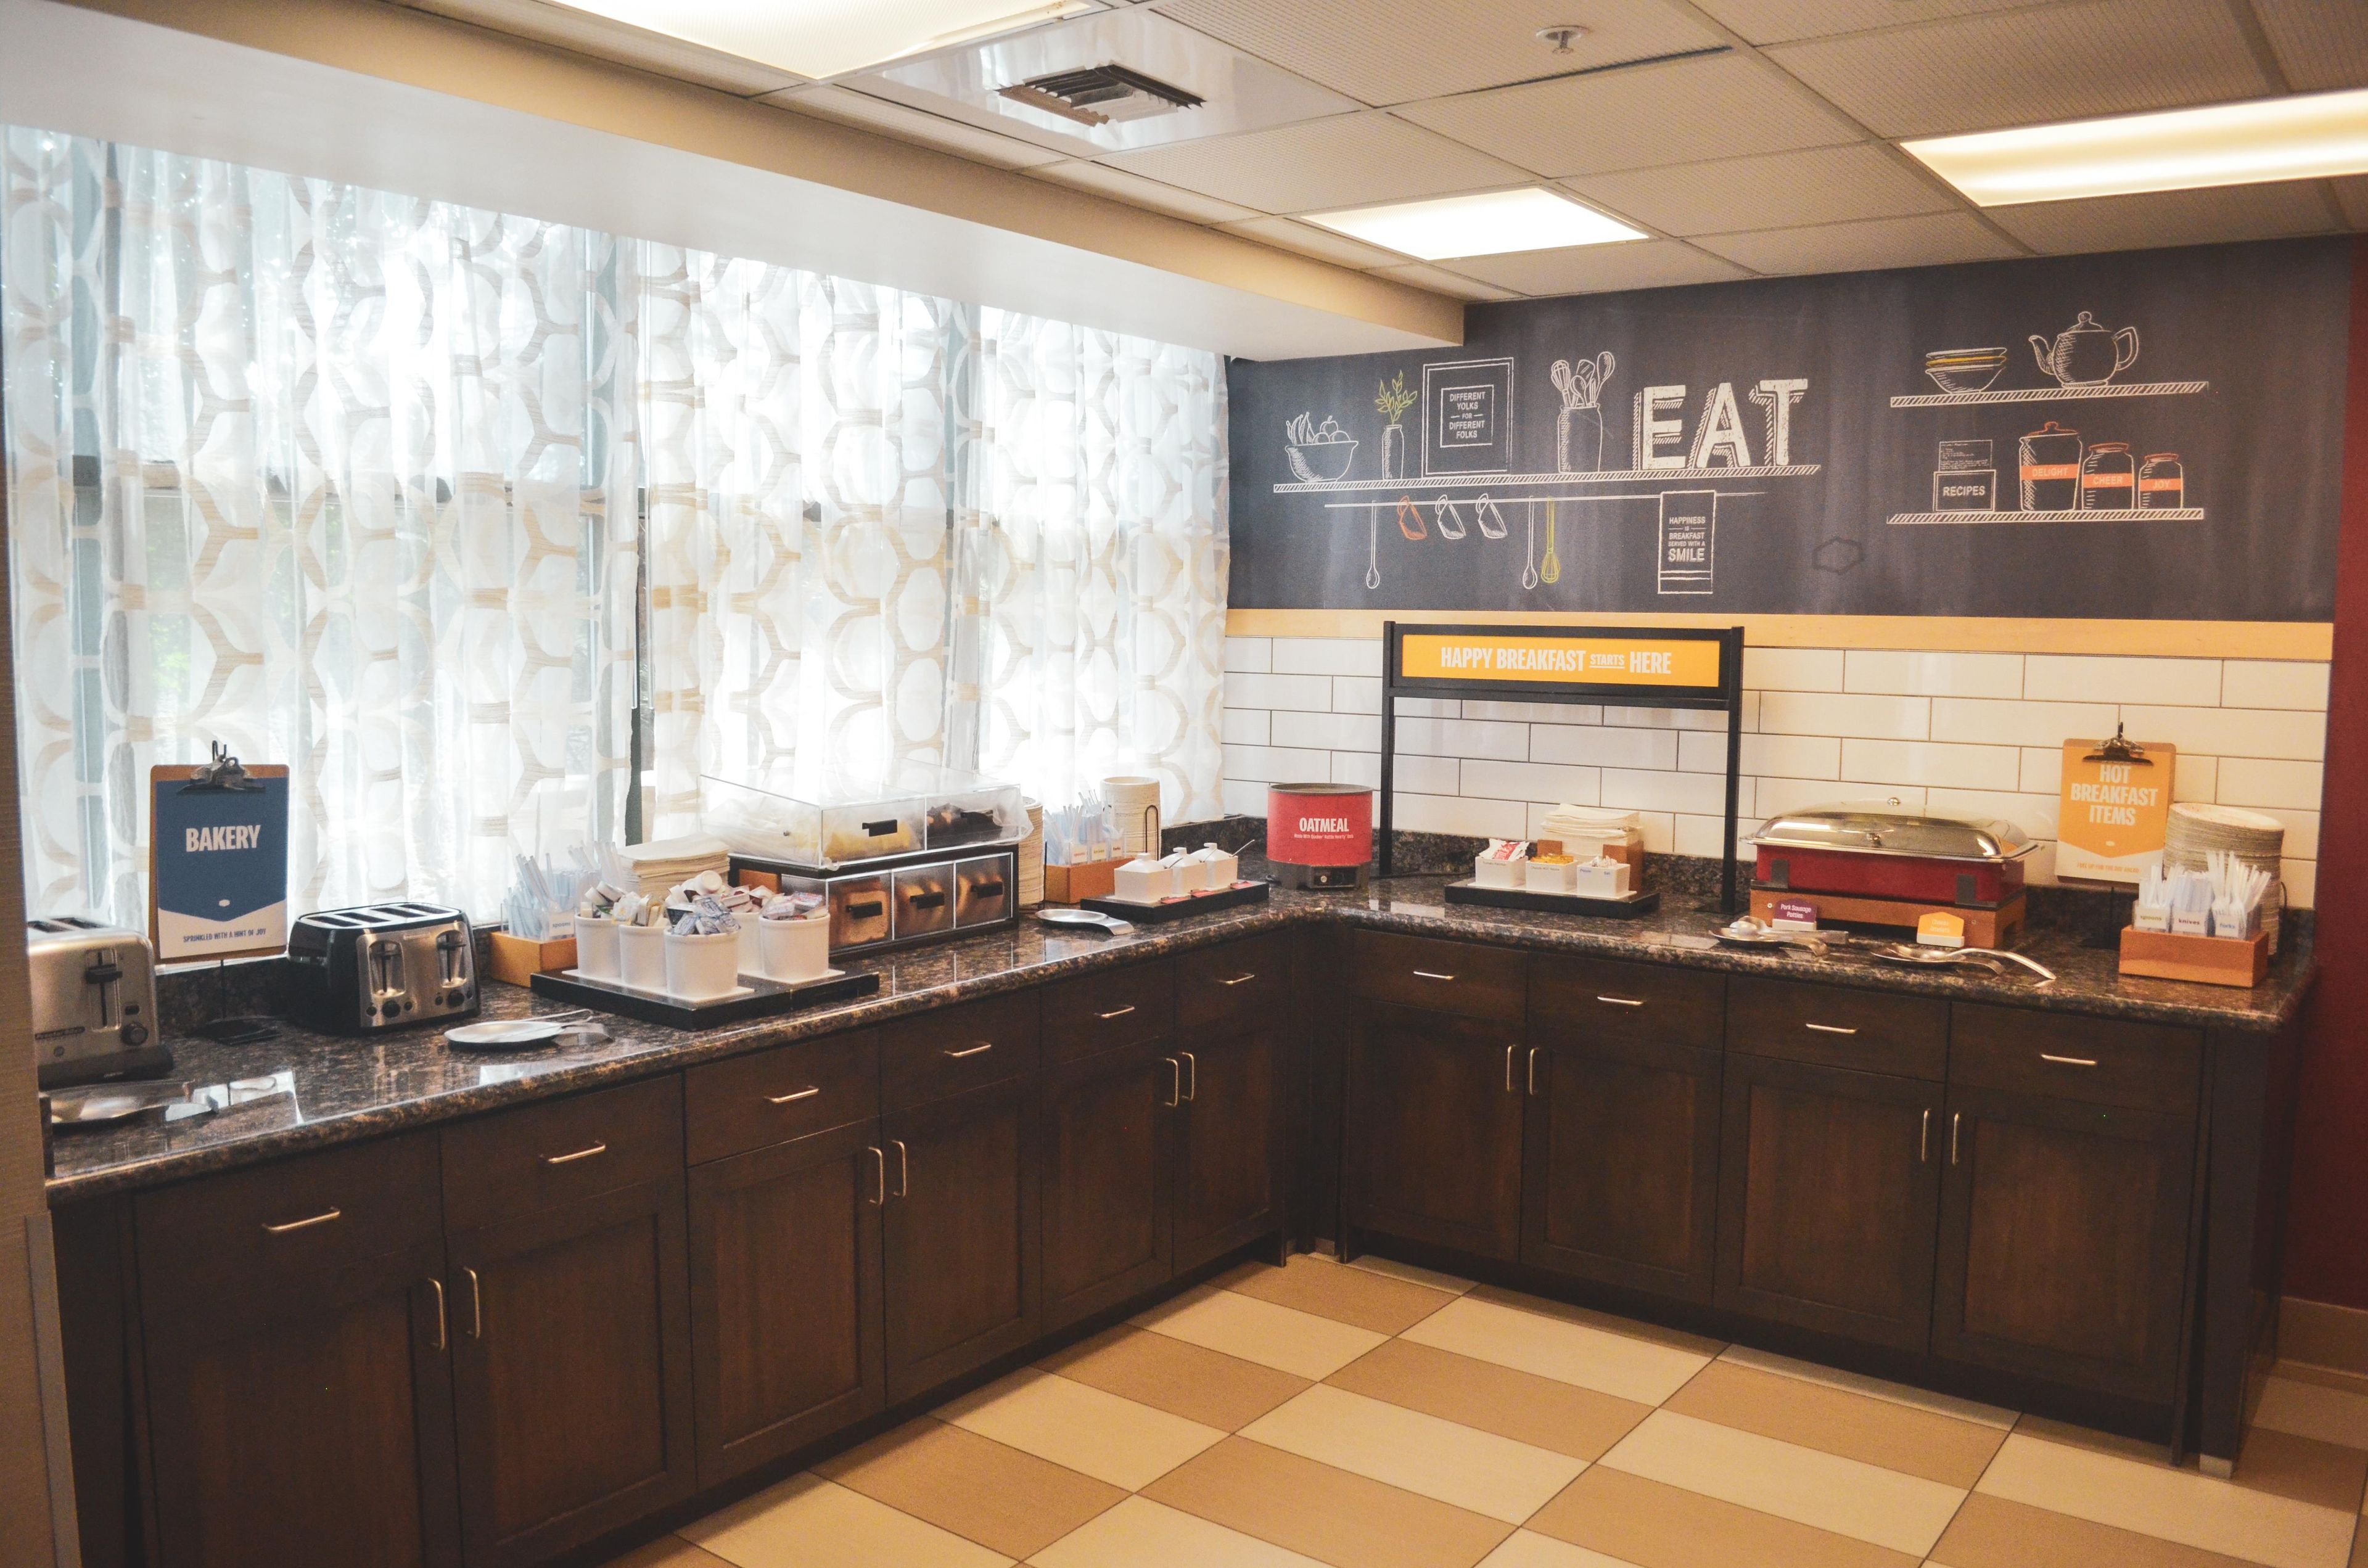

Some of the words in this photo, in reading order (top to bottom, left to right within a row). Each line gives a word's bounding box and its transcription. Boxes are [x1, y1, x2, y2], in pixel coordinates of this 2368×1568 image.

[1450, 392, 1486, 402] DIFFERENT
[1457, 401, 1478, 410] YOLKS
[1449, 421, 1485, 430] DIFFERENT
[1633, 379, 1808, 470] EAT
[1456, 430, 1478, 439] FOLKS
[2032, 467, 2068, 477] DELIGHT
[2093, 475, 2123, 485] CHEER
[2153, 480, 2171, 489] JOY
[1943, 485, 1986, 496] RECIPES
[1669, 516, 1706, 524] HAPPINESS
[1668, 548, 1705, 562] SMILE
[1441, 647, 1493, 668] HAPPY
[1496, 648, 1586, 671] BREAKFAST
[1589, 654, 1625, 666] STARTS
[1630, 651, 1672, 674] HERE
[2099, 764, 2131, 784] HOT
[2071, 782, 2158, 807] BREAKFAST
[2089, 805, 2136, 826] ITEMS
[1299, 817, 1349, 832] OATMEAL
[186, 824, 261, 852] BAKERY
[1791, 905, 1812, 913] Sausage
[183, 934, 213, 943] SPRINKLED
[214, 932, 228, 940] WITH
[234, 930, 247, 938] HINT
